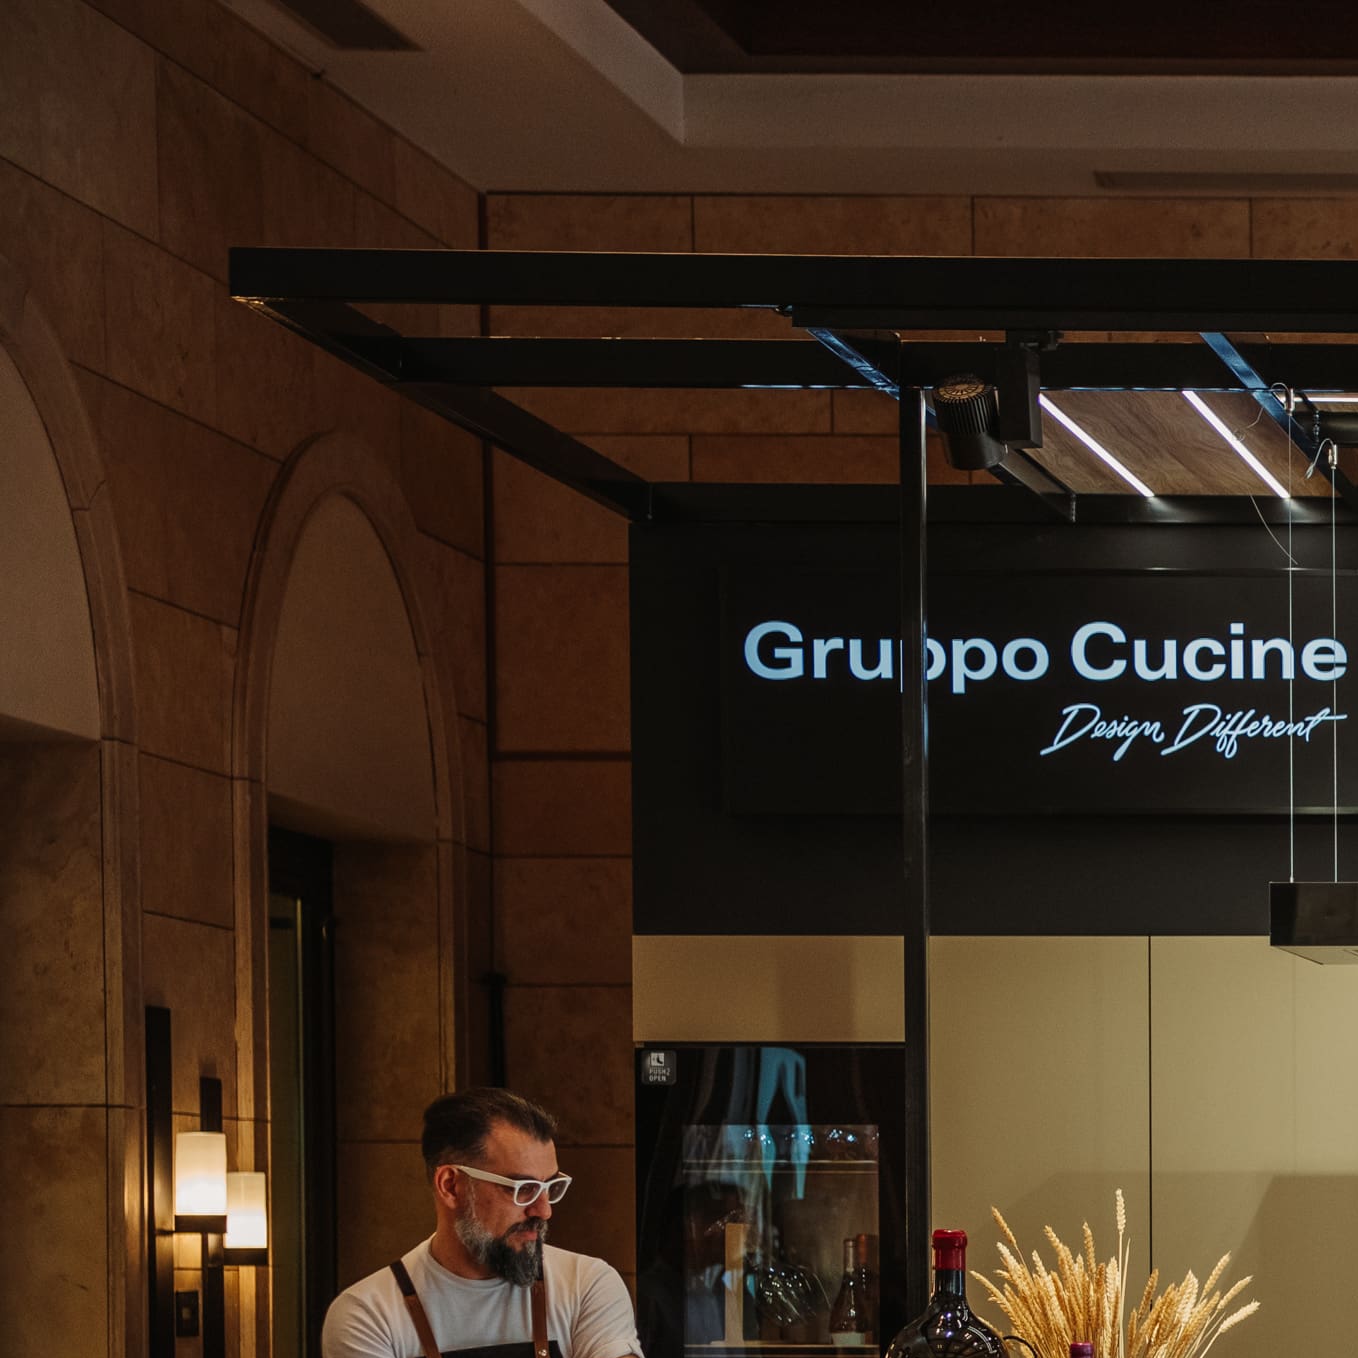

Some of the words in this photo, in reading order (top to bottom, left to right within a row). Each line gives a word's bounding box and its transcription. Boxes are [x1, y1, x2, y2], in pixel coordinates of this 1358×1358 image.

[1070, 622, 1348, 682] Cucine
[1039, 703, 1165, 761] Design
[1160, 703, 1348, 759] Different
